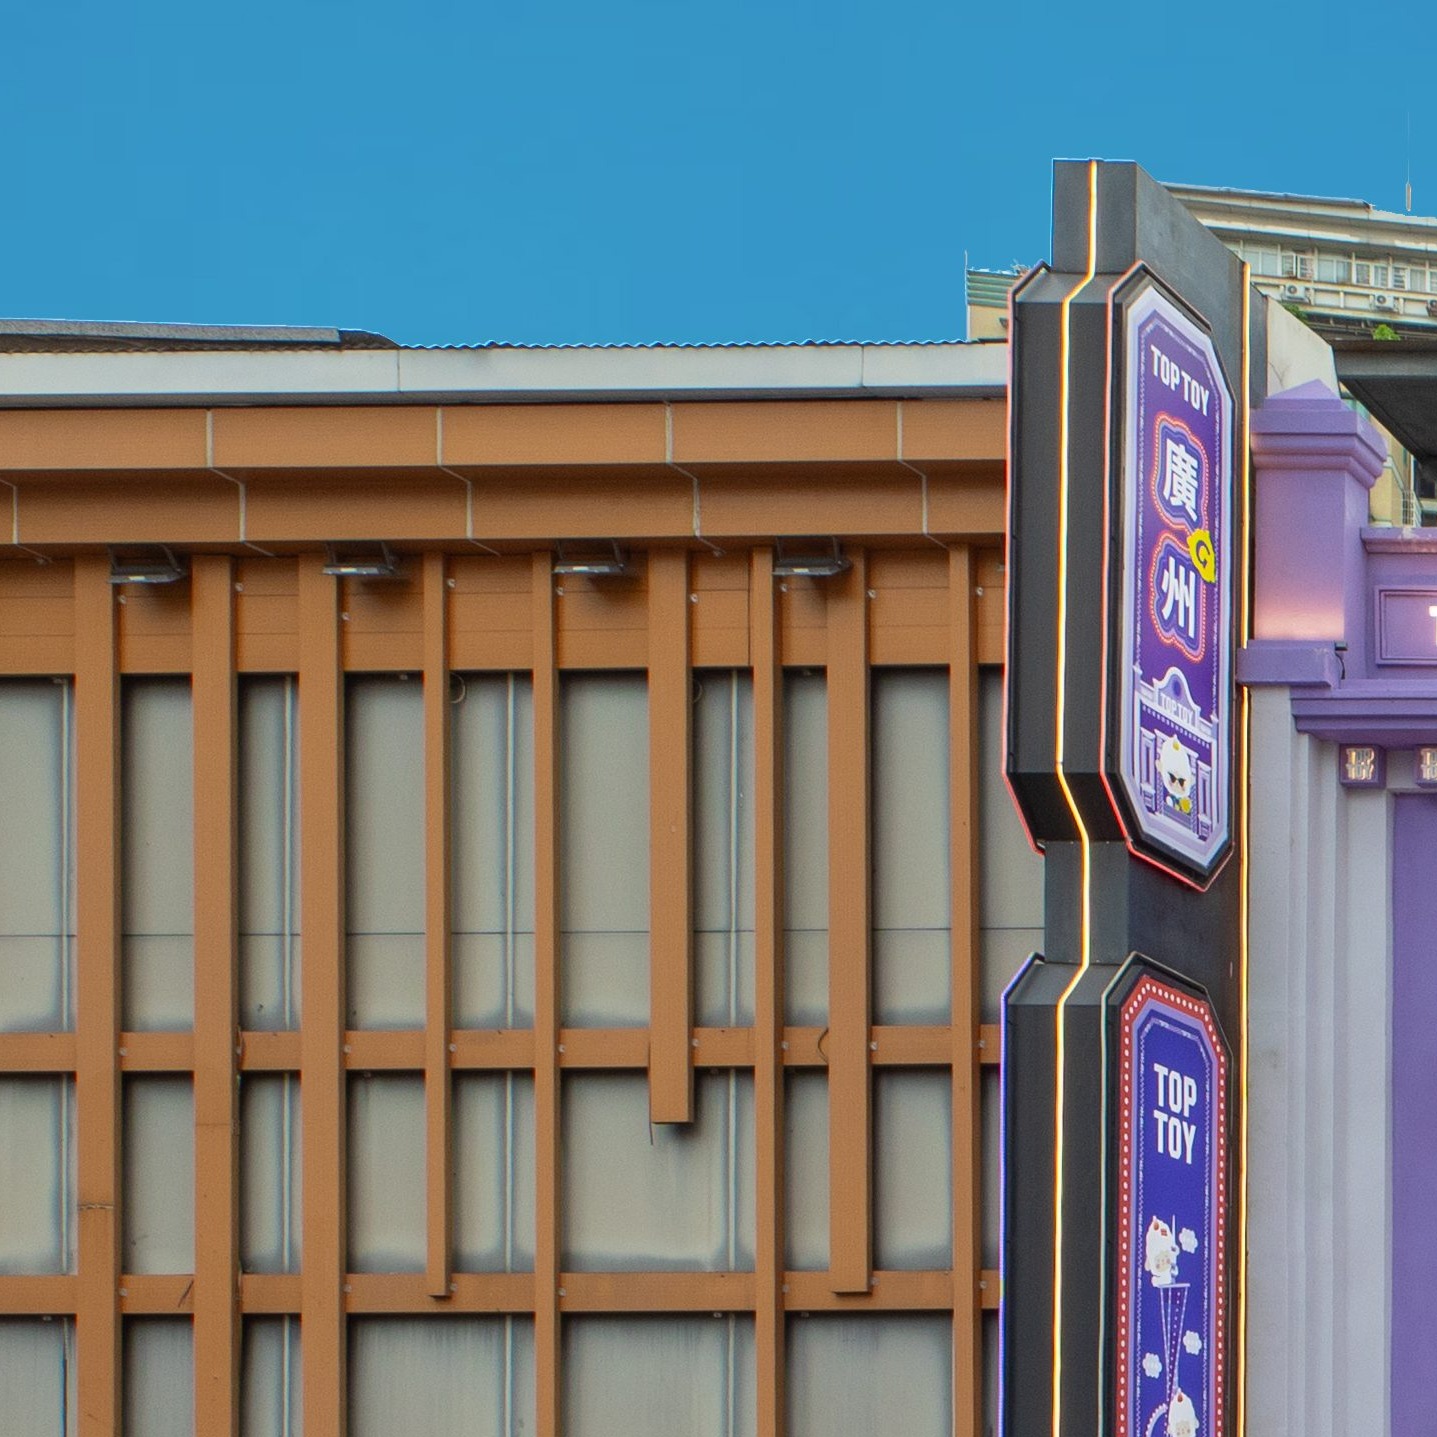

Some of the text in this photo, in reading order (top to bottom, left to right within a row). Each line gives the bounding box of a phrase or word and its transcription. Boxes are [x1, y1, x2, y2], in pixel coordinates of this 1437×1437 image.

[1151, 344, 1210, 418] TOP TOY
[1161, 438, 1199, 640] 廣州
[1154, 1062, 1197, 1114] TOP
[1154, 1111, 1197, 1164] TOY
